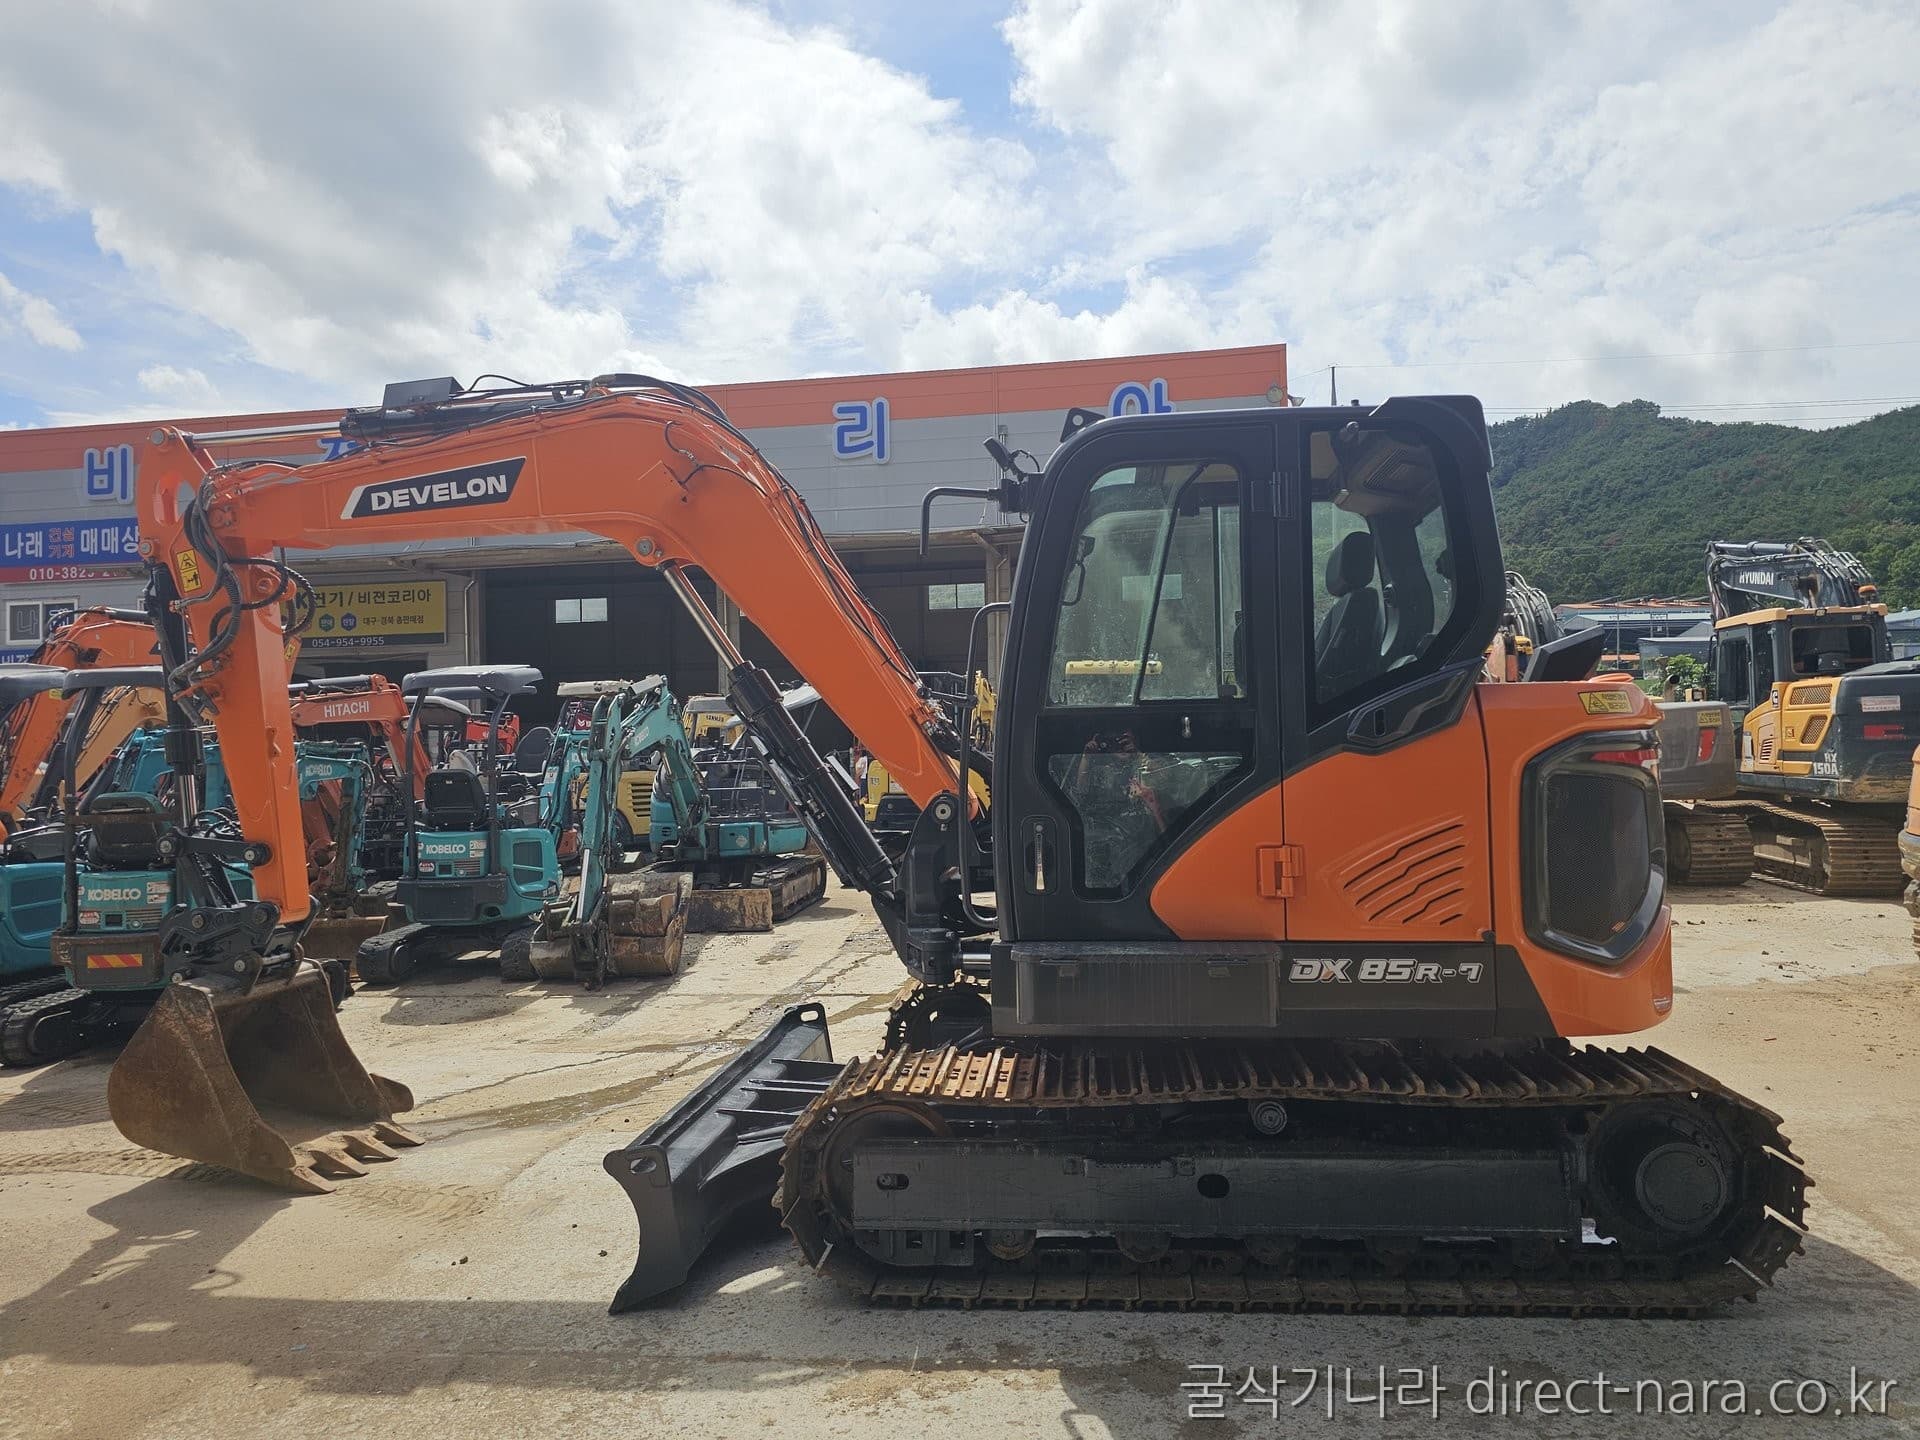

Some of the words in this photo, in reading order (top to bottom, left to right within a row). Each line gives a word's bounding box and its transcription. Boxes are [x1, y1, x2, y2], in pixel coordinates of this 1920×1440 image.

[84, 446, 132, 502] 비
[834, 398, 889, 463] 리
[371, 474, 507, 511] DEVELON
[4, 530, 43, 559] 나래
[1739, 571, 1774, 586] HYUNDAI
[312, 636, 385, 648] 054-954-9955
[324, 701, 370, 717] HITACHI
[426, 844, 466, 855] KOBELCO
[87, 888, 141, 901] KOBELCO
[1289, 958, 1353, 984] DX
